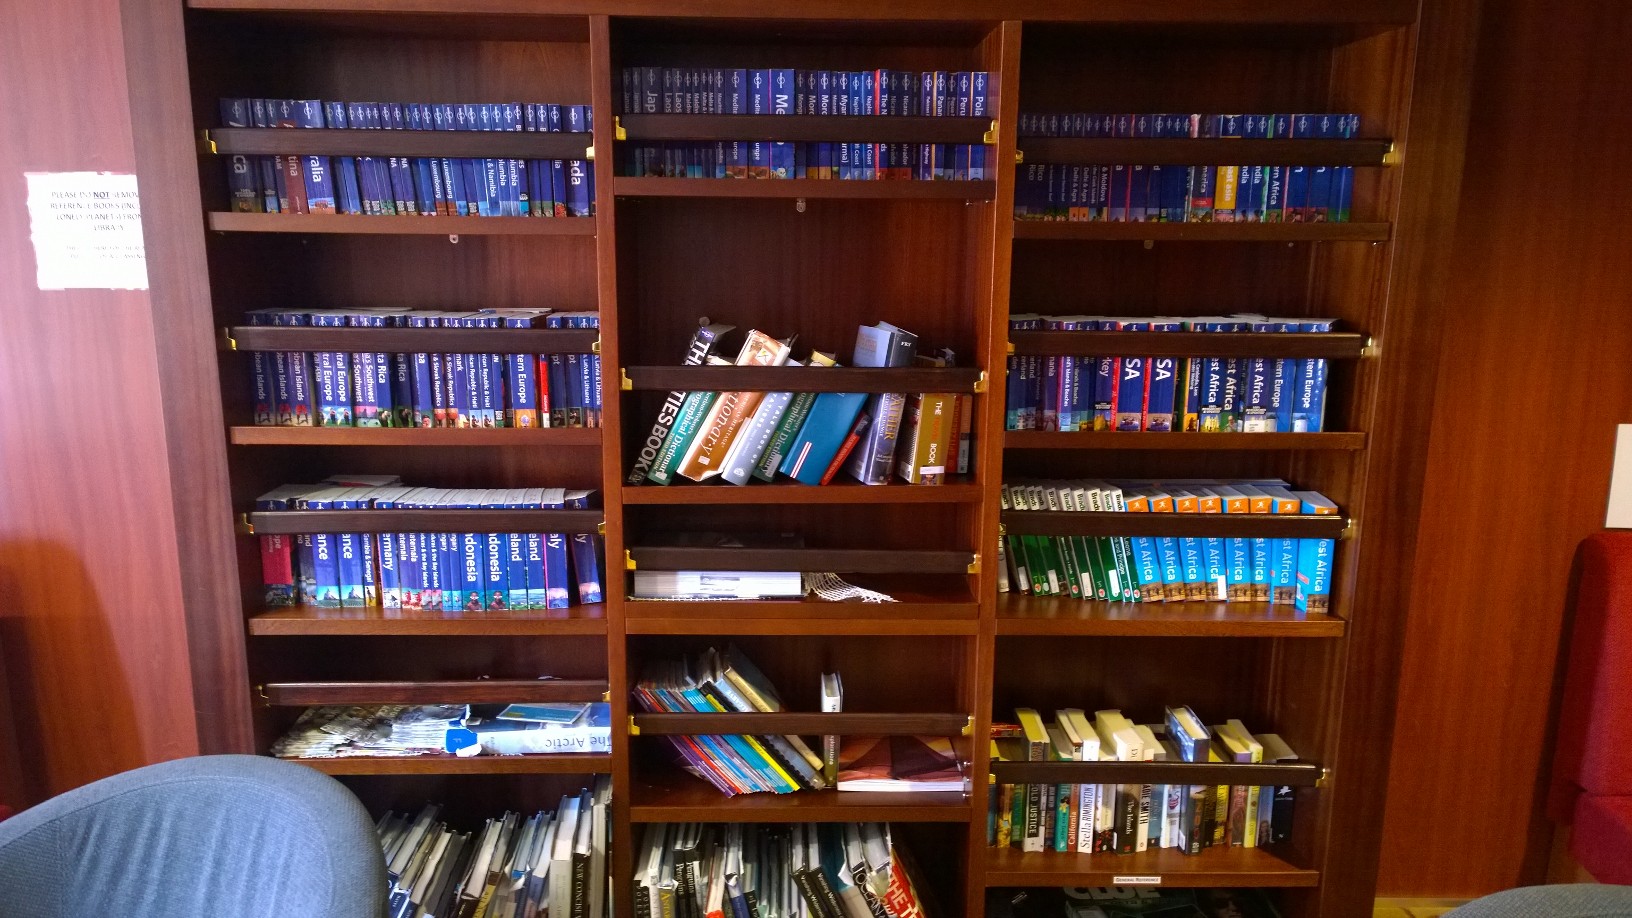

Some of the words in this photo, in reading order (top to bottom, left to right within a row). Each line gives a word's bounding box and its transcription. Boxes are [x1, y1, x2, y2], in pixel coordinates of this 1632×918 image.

[431, 160, 442, 199] Luxembourg
[442, 160, 454, 199] Luxembourg
[488, 170, 496, 198] Namibia
[1270, 180, 1280, 205] Africa
[93, 191, 110, 199] NOT
[354, 364, 363, 402] Southwest
[365, 364, 374, 402] Southwest
[378, 364, 386, 384] Rica
[398, 364, 406, 382] Rica
[1124, 358, 1140, 381] SA
[1156, 358, 1172, 382] SA
[256, 374, 265, 400] Islands
[278, 374, 287, 400] Islands
[296, 375, 304, 401] Islands
[324, 370, 332, 402] Europe
[338, 370, 346, 402] Europe
[518, 373, 527, 404] Europe
[1208, 374, 1219, 403] Africa
[1224, 376, 1236, 411] Africa
[1252, 374, 1263, 404] Africa
[1271, 379, 1283, 408] Europe
[1302, 380, 1314, 408] Europe
[934, 402, 943, 416] THE
[638, 425, 668, 474] BOOK
[660, 434, 682, 474] Dictionar
[928, 443, 938, 464] BOOK
[1141, 551, 1154, 581] Africa
[1164, 550, 1176, 581] Africa
[1186, 550, 1197, 580] Africa
[1209, 550, 1218, 580] Africa
[1234, 550, 1245, 582] Africa
[1254, 550, 1266, 582] Africa
[1280, 554, 1292, 584] Africa
[1314, 560, 1328, 592] Africa
[545, 736, 585, 749] Arctic
[1028, 804, 1038, 834] JUSTICE
[1140, 801, 1150, 825] SMITH
[1068, 812, 1076, 845] California
[1080, 822, 1091, 848] Stella
